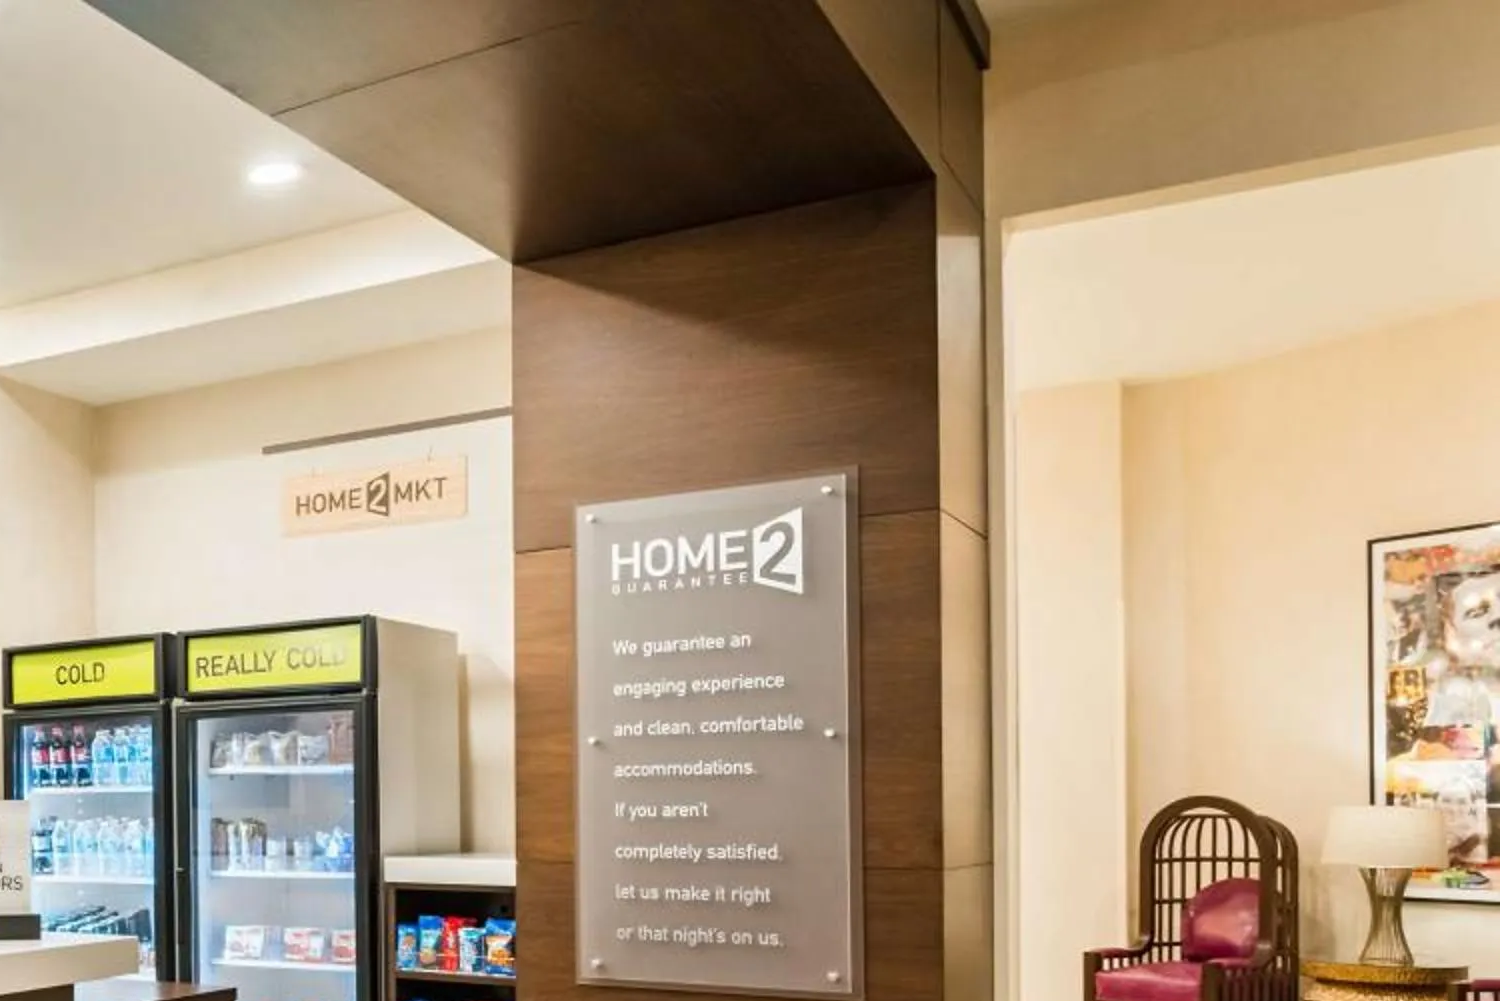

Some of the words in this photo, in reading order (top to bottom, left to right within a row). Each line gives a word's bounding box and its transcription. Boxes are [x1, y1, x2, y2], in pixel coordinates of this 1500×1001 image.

[611, 572, 749, 595] GUARANTEE
[613, 639, 637, 656] We
[642, 635, 725, 657] guarantee
[729, 633, 752, 649] an
[196, 650, 277, 679] REALLY
[286, 643, 347, 670] COLD
[55, 661, 106, 686] COLD
[613, 679, 687, 698] engaging
[691, 674, 785, 694] experience
[613, 720, 643, 737] and
[699, 714, 804, 733] comfortable
[614, 802, 625, 817] If
[629, 805, 657, 822] you
[614, 843, 702, 863] completely
[614, 884, 636, 900] let
[639, 886, 659, 900] us
[665, 885, 711, 901] make
[715, 886, 726, 902] it
[730, 887, 771, 906] right
[616, 926, 633, 941] or
[637, 925, 668, 942] that
[731, 931, 753, 945] on
